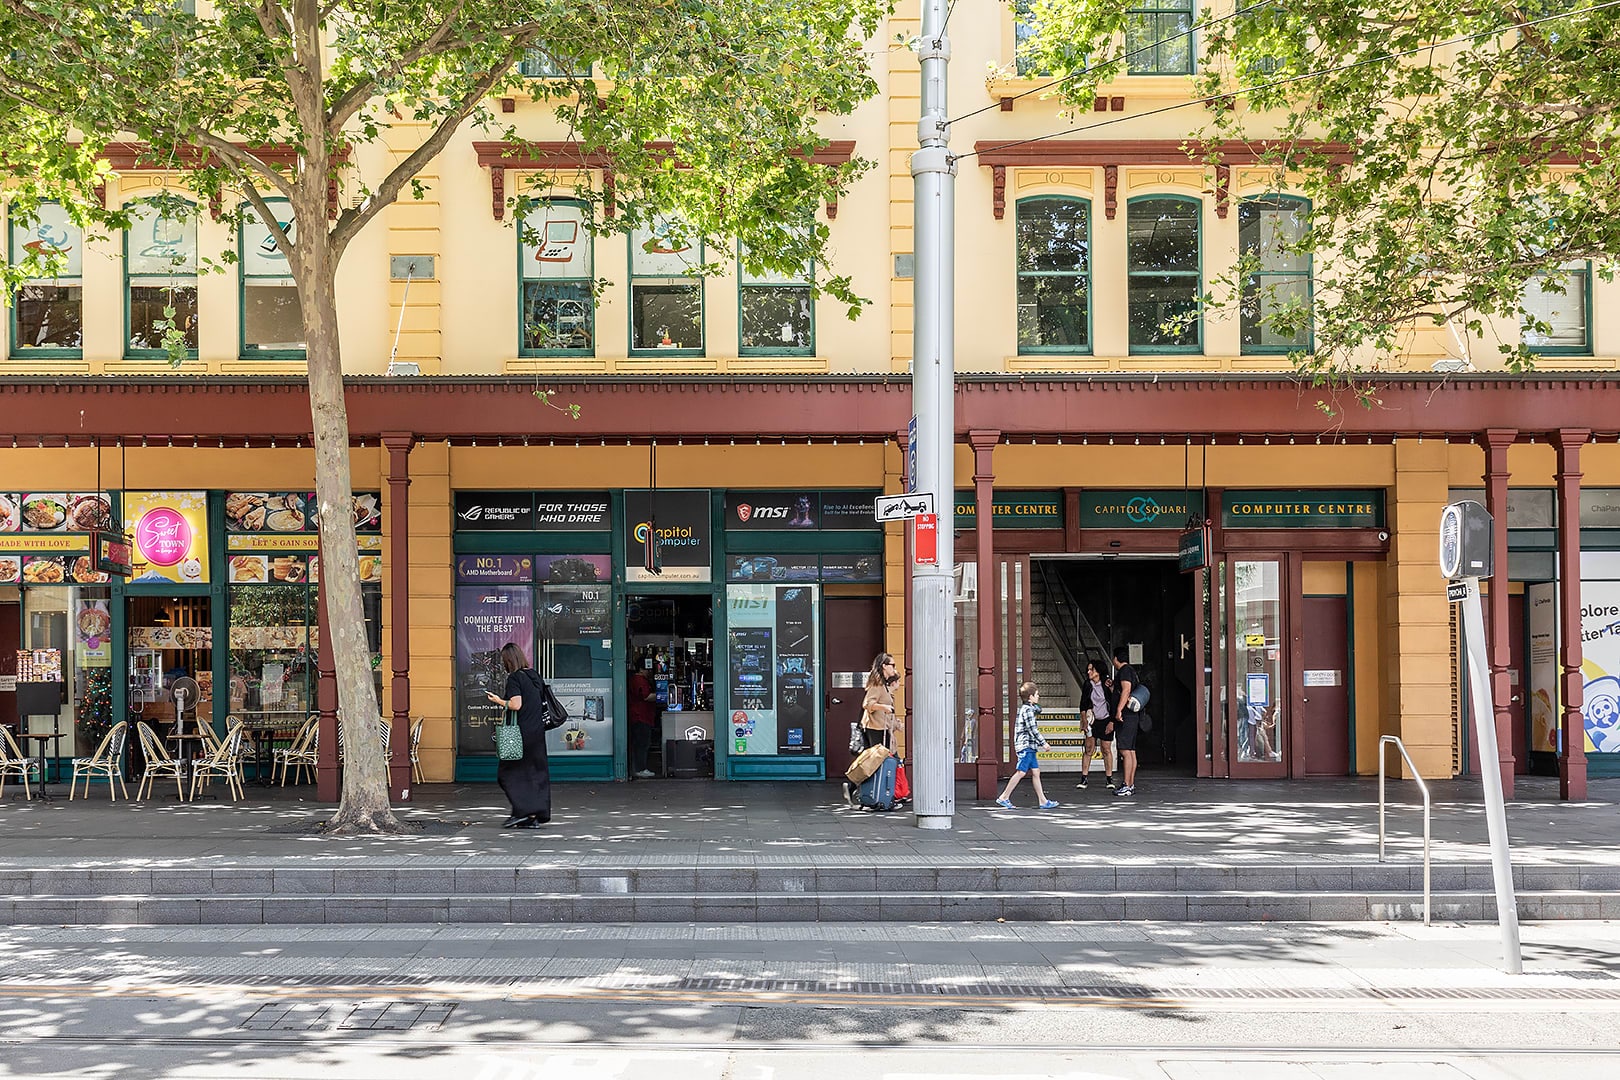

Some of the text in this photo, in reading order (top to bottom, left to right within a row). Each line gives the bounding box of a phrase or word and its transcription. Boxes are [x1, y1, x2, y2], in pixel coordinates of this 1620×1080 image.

[538, 503, 607, 512] FOR THOSE
[1015, 505, 1057, 514] CENTRE
[1094, 505, 1187, 514] CAPITOL SQUARE
[1232, 504, 1372, 514] COMPUTER CENTRE
[753, 507, 788, 518] msi
[540, 514, 602, 523] WHO DARE
[144, 516, 182, 549] Sweet
[160, 540, 185, 548] TOWN
[476, 558, 502, 568] NO.1
[582, 591, 599, 600] NO.1
[1580, 604, 1618, 618] plore
[464, 616, 526, 624] DOMINATE WITH
[476, 624, 513, 632] THE BEST
